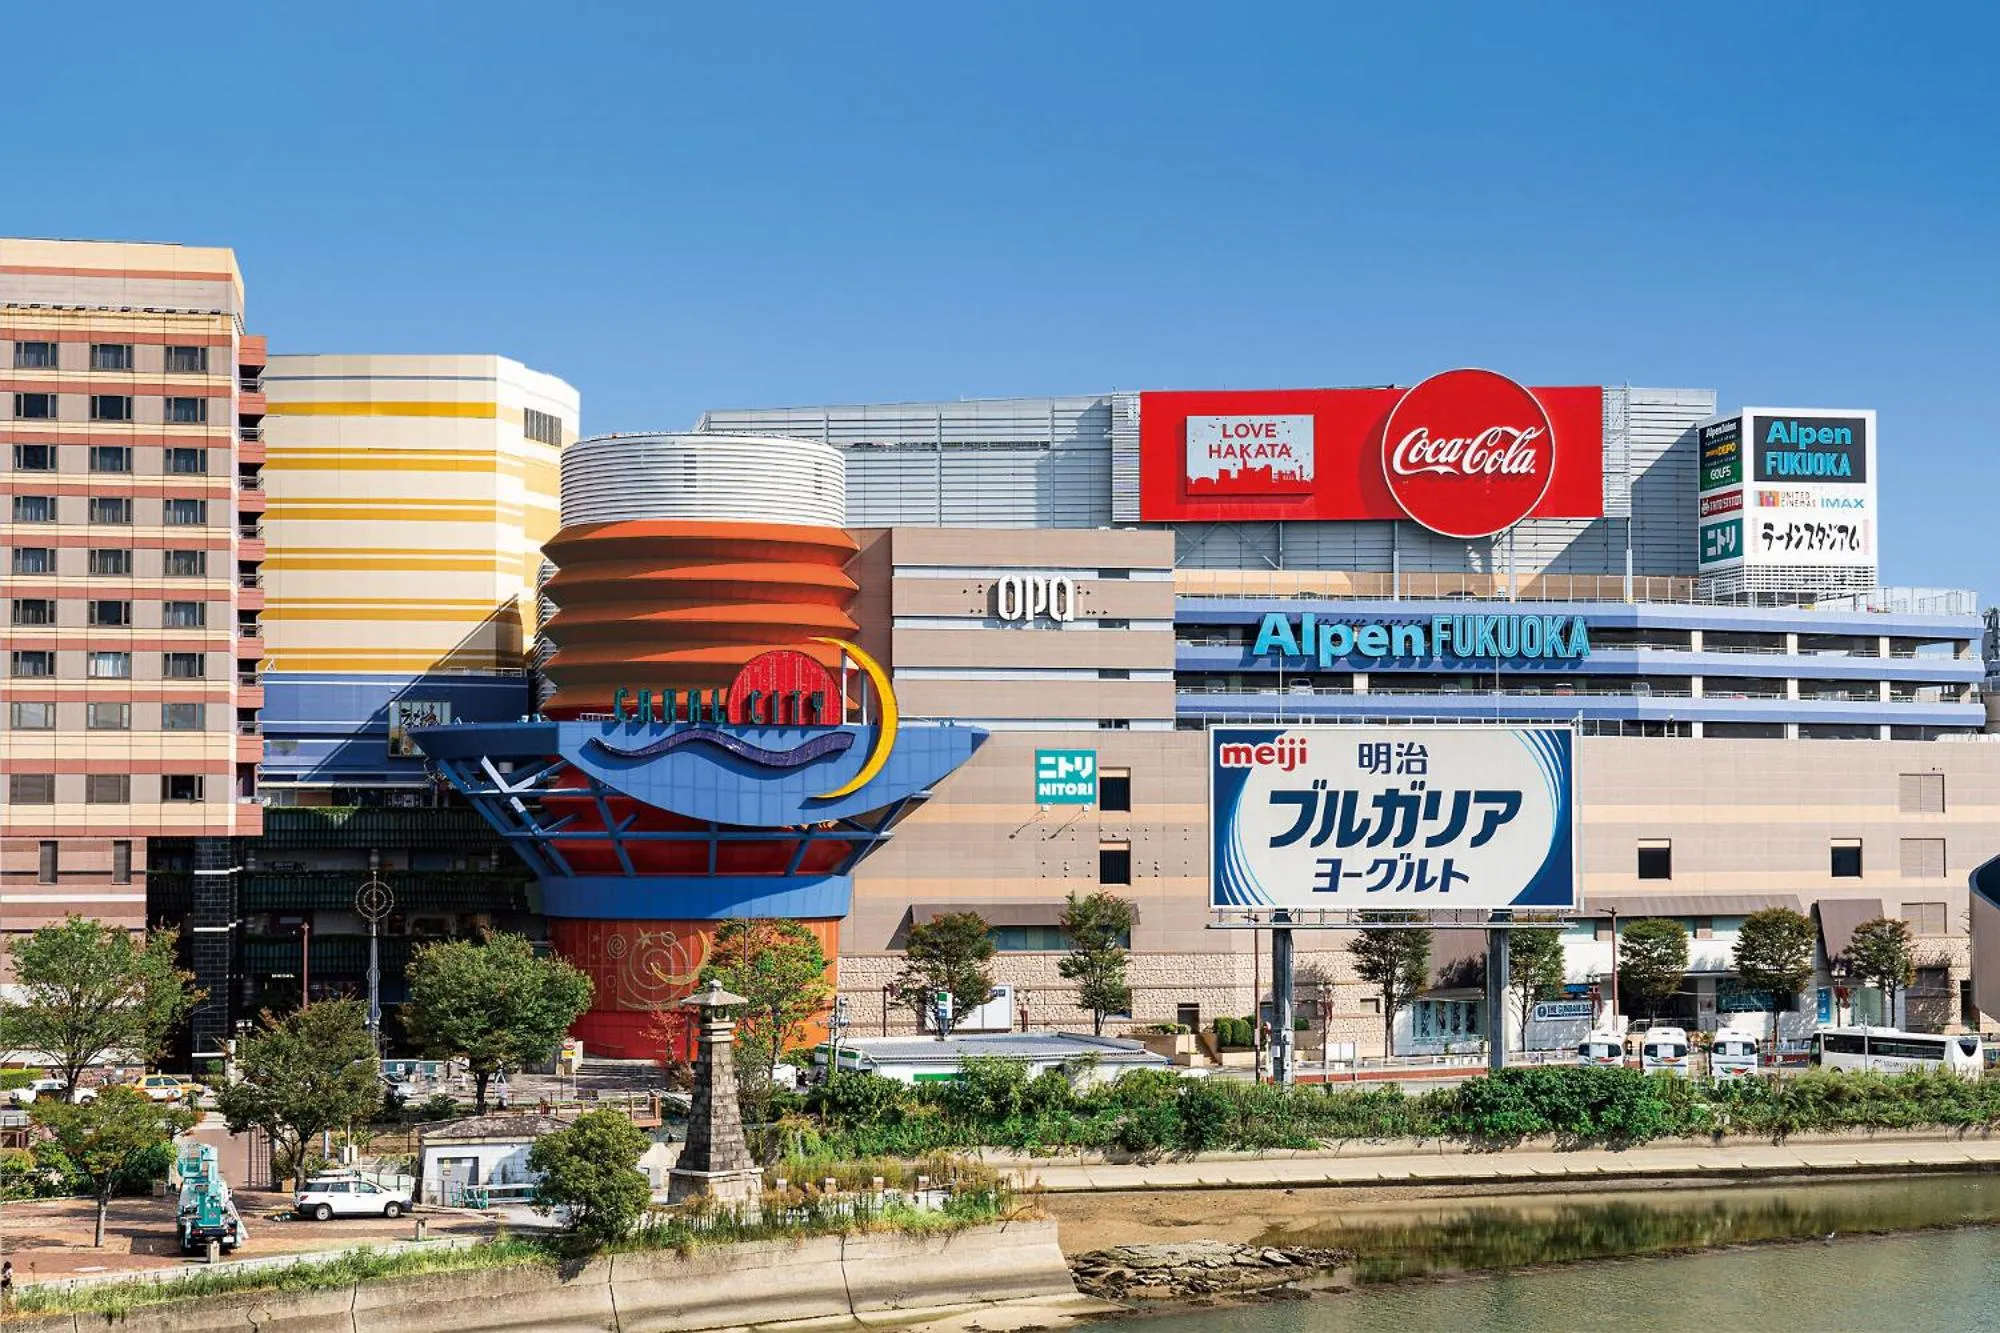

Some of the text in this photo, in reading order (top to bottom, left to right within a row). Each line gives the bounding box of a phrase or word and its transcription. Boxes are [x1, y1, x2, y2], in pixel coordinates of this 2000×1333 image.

[1222, 423, 1277, 439] LOVE
[1766, 420, 1852, 449] Alpen
[1208, 443, 1292, 459] HAKATA
[1393, 426, 1546, 475] Coca-Cola
[1766, 451, 1851, 477] FUKUOKA
[1781, 491, 1811, 499] UNITED
[1781, 499, 1817, 508] CINEMAS
[1820, 498, 1865, 509] IMAX
[1707, 525, 1736, 557] ニトリ
[1761, 522, 1860, 551] ラーメンスタジアム
[998, 575, 1074, 622] OPA
[1253, 612, 1591, 668] Alpen FUKUOKA
[613, 687, 825, 725] CANAL CITY
[1039, 756, 1093, 779] ニトリ
[1220, 738, 1308, 772] meiji
[1357, 742, 1429, 776] 明治
[1039, 783, 1093, 796] NITORI
[1269, 780, 1523, 849] ブルガリア
[1312, 853, 1470, 893] ヨーグルト
